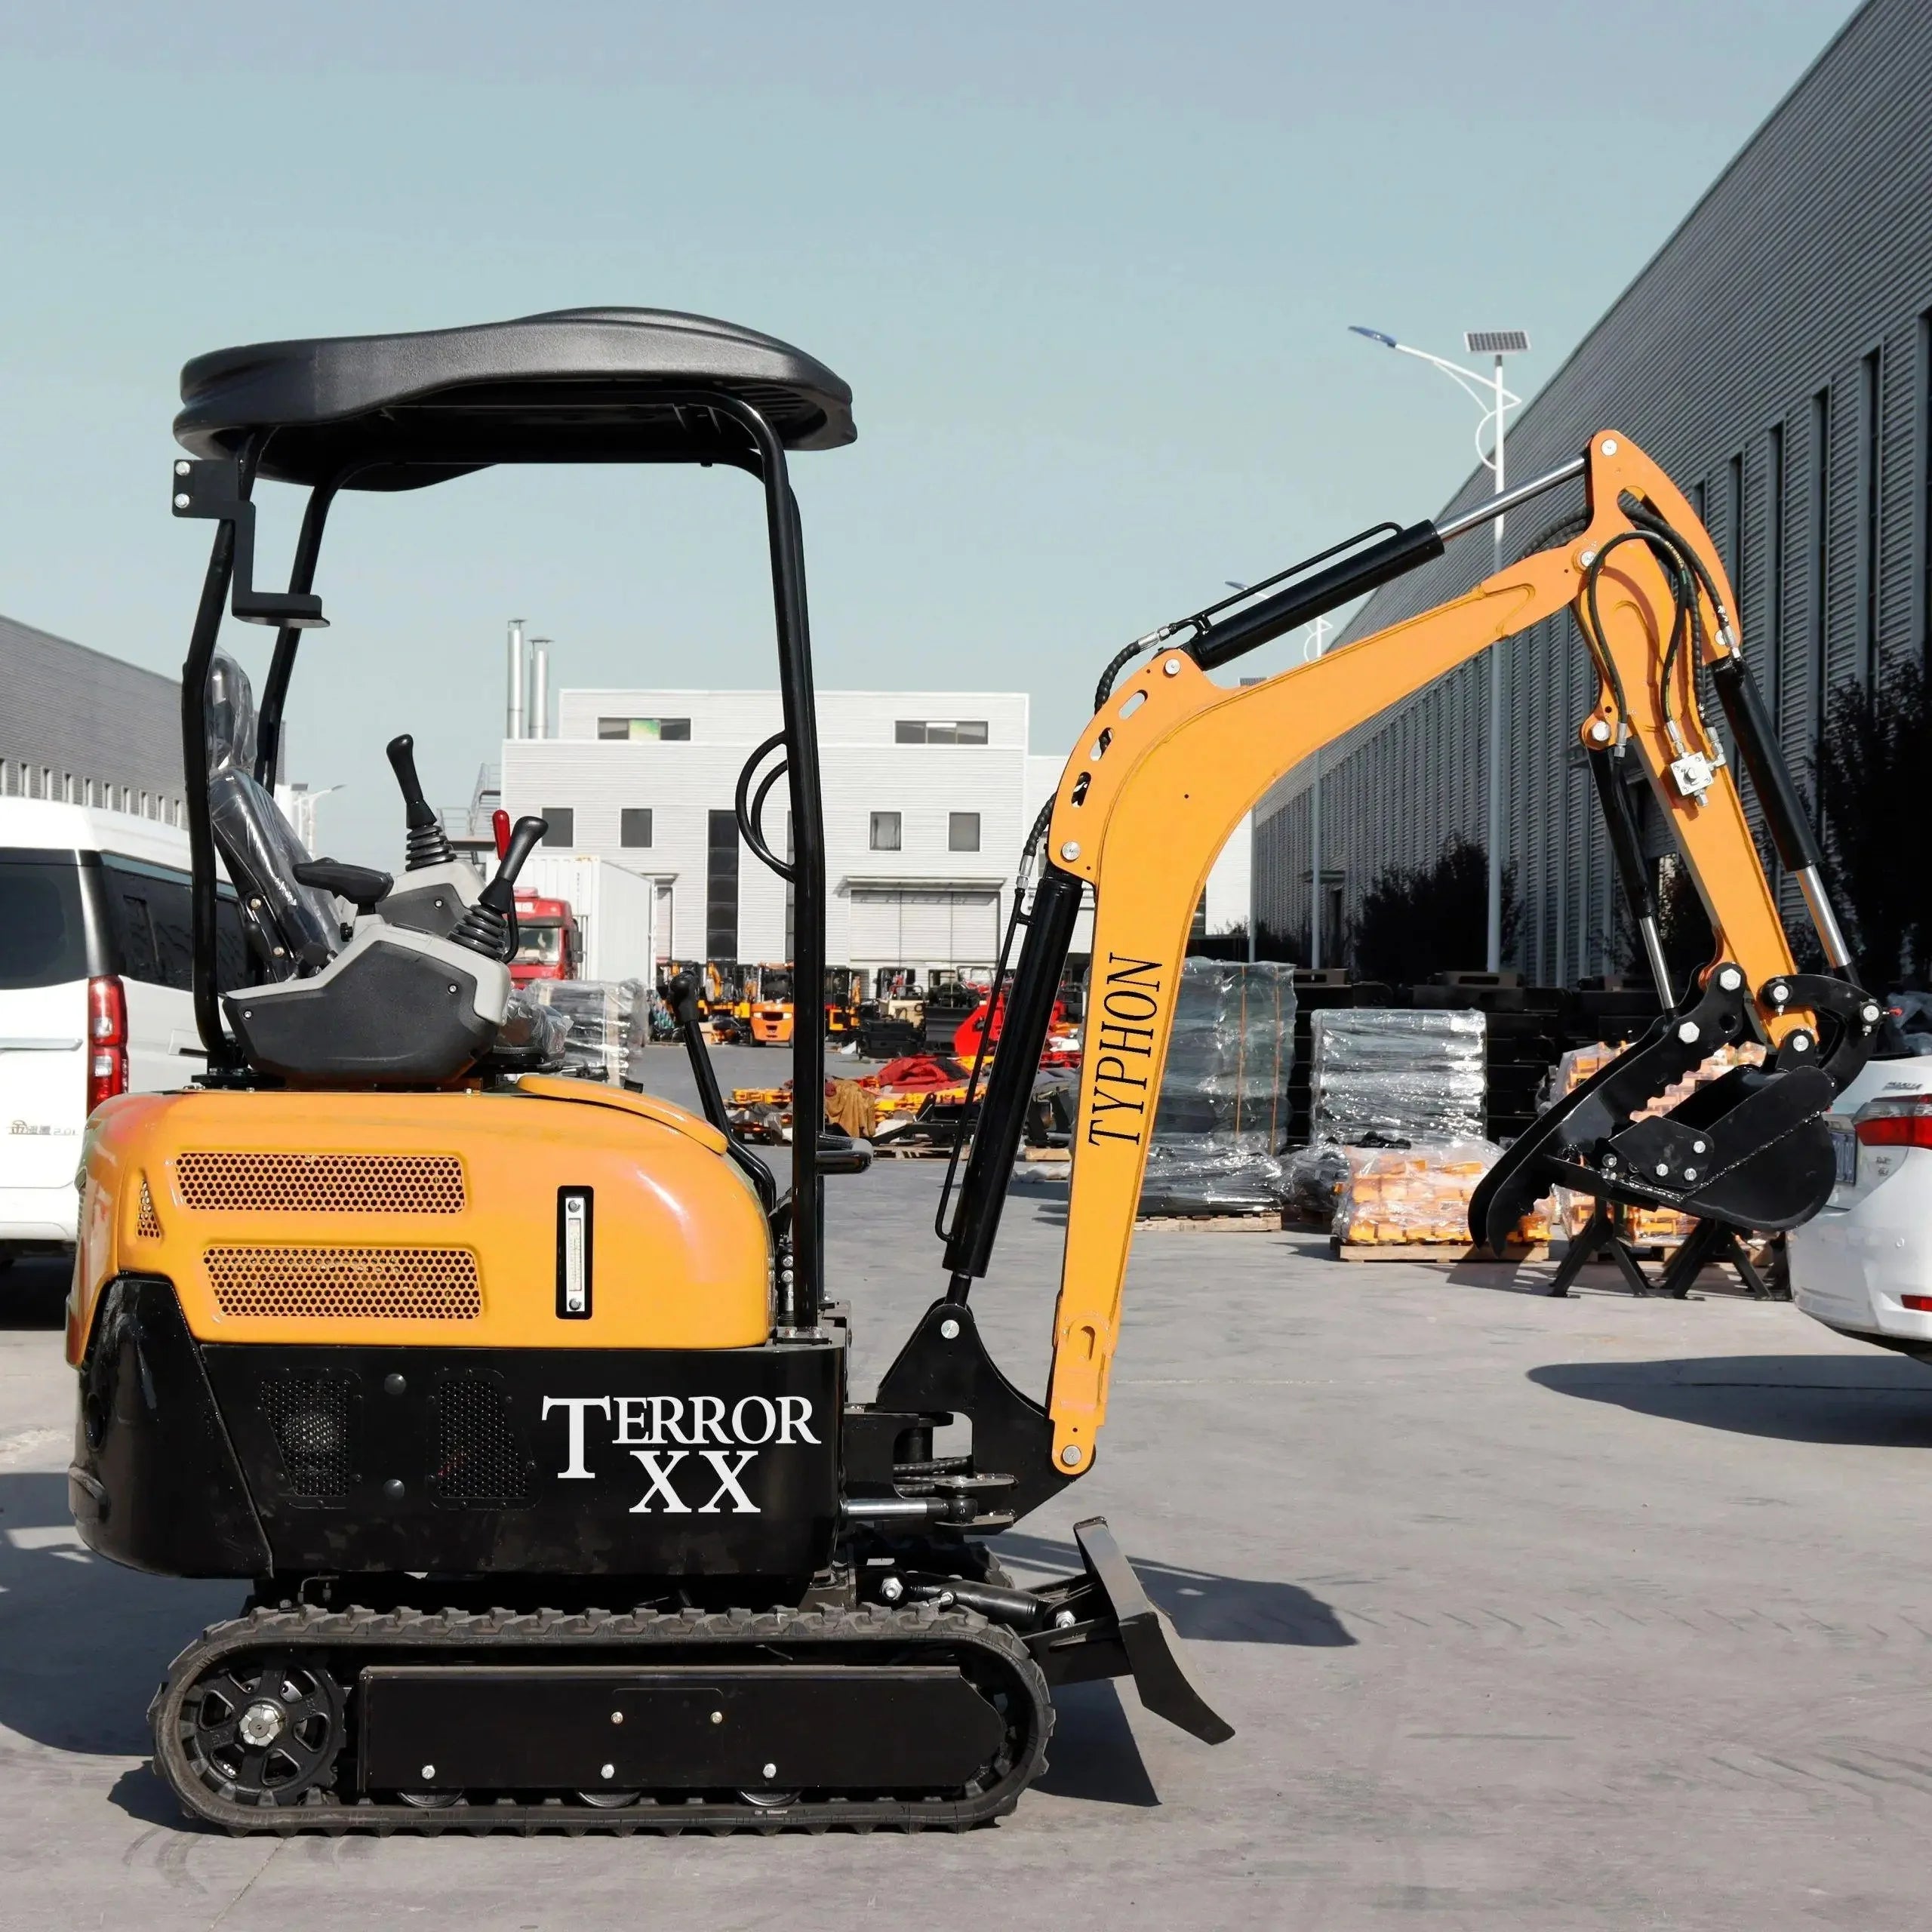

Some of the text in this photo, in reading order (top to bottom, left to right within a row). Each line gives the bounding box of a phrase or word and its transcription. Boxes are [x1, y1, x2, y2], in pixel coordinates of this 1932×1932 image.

[1089, 952, 1162, 1146] TYPHON
[542, 1395, 821, 1478] TERROR
[629, 1451, 761, 1513] XX
